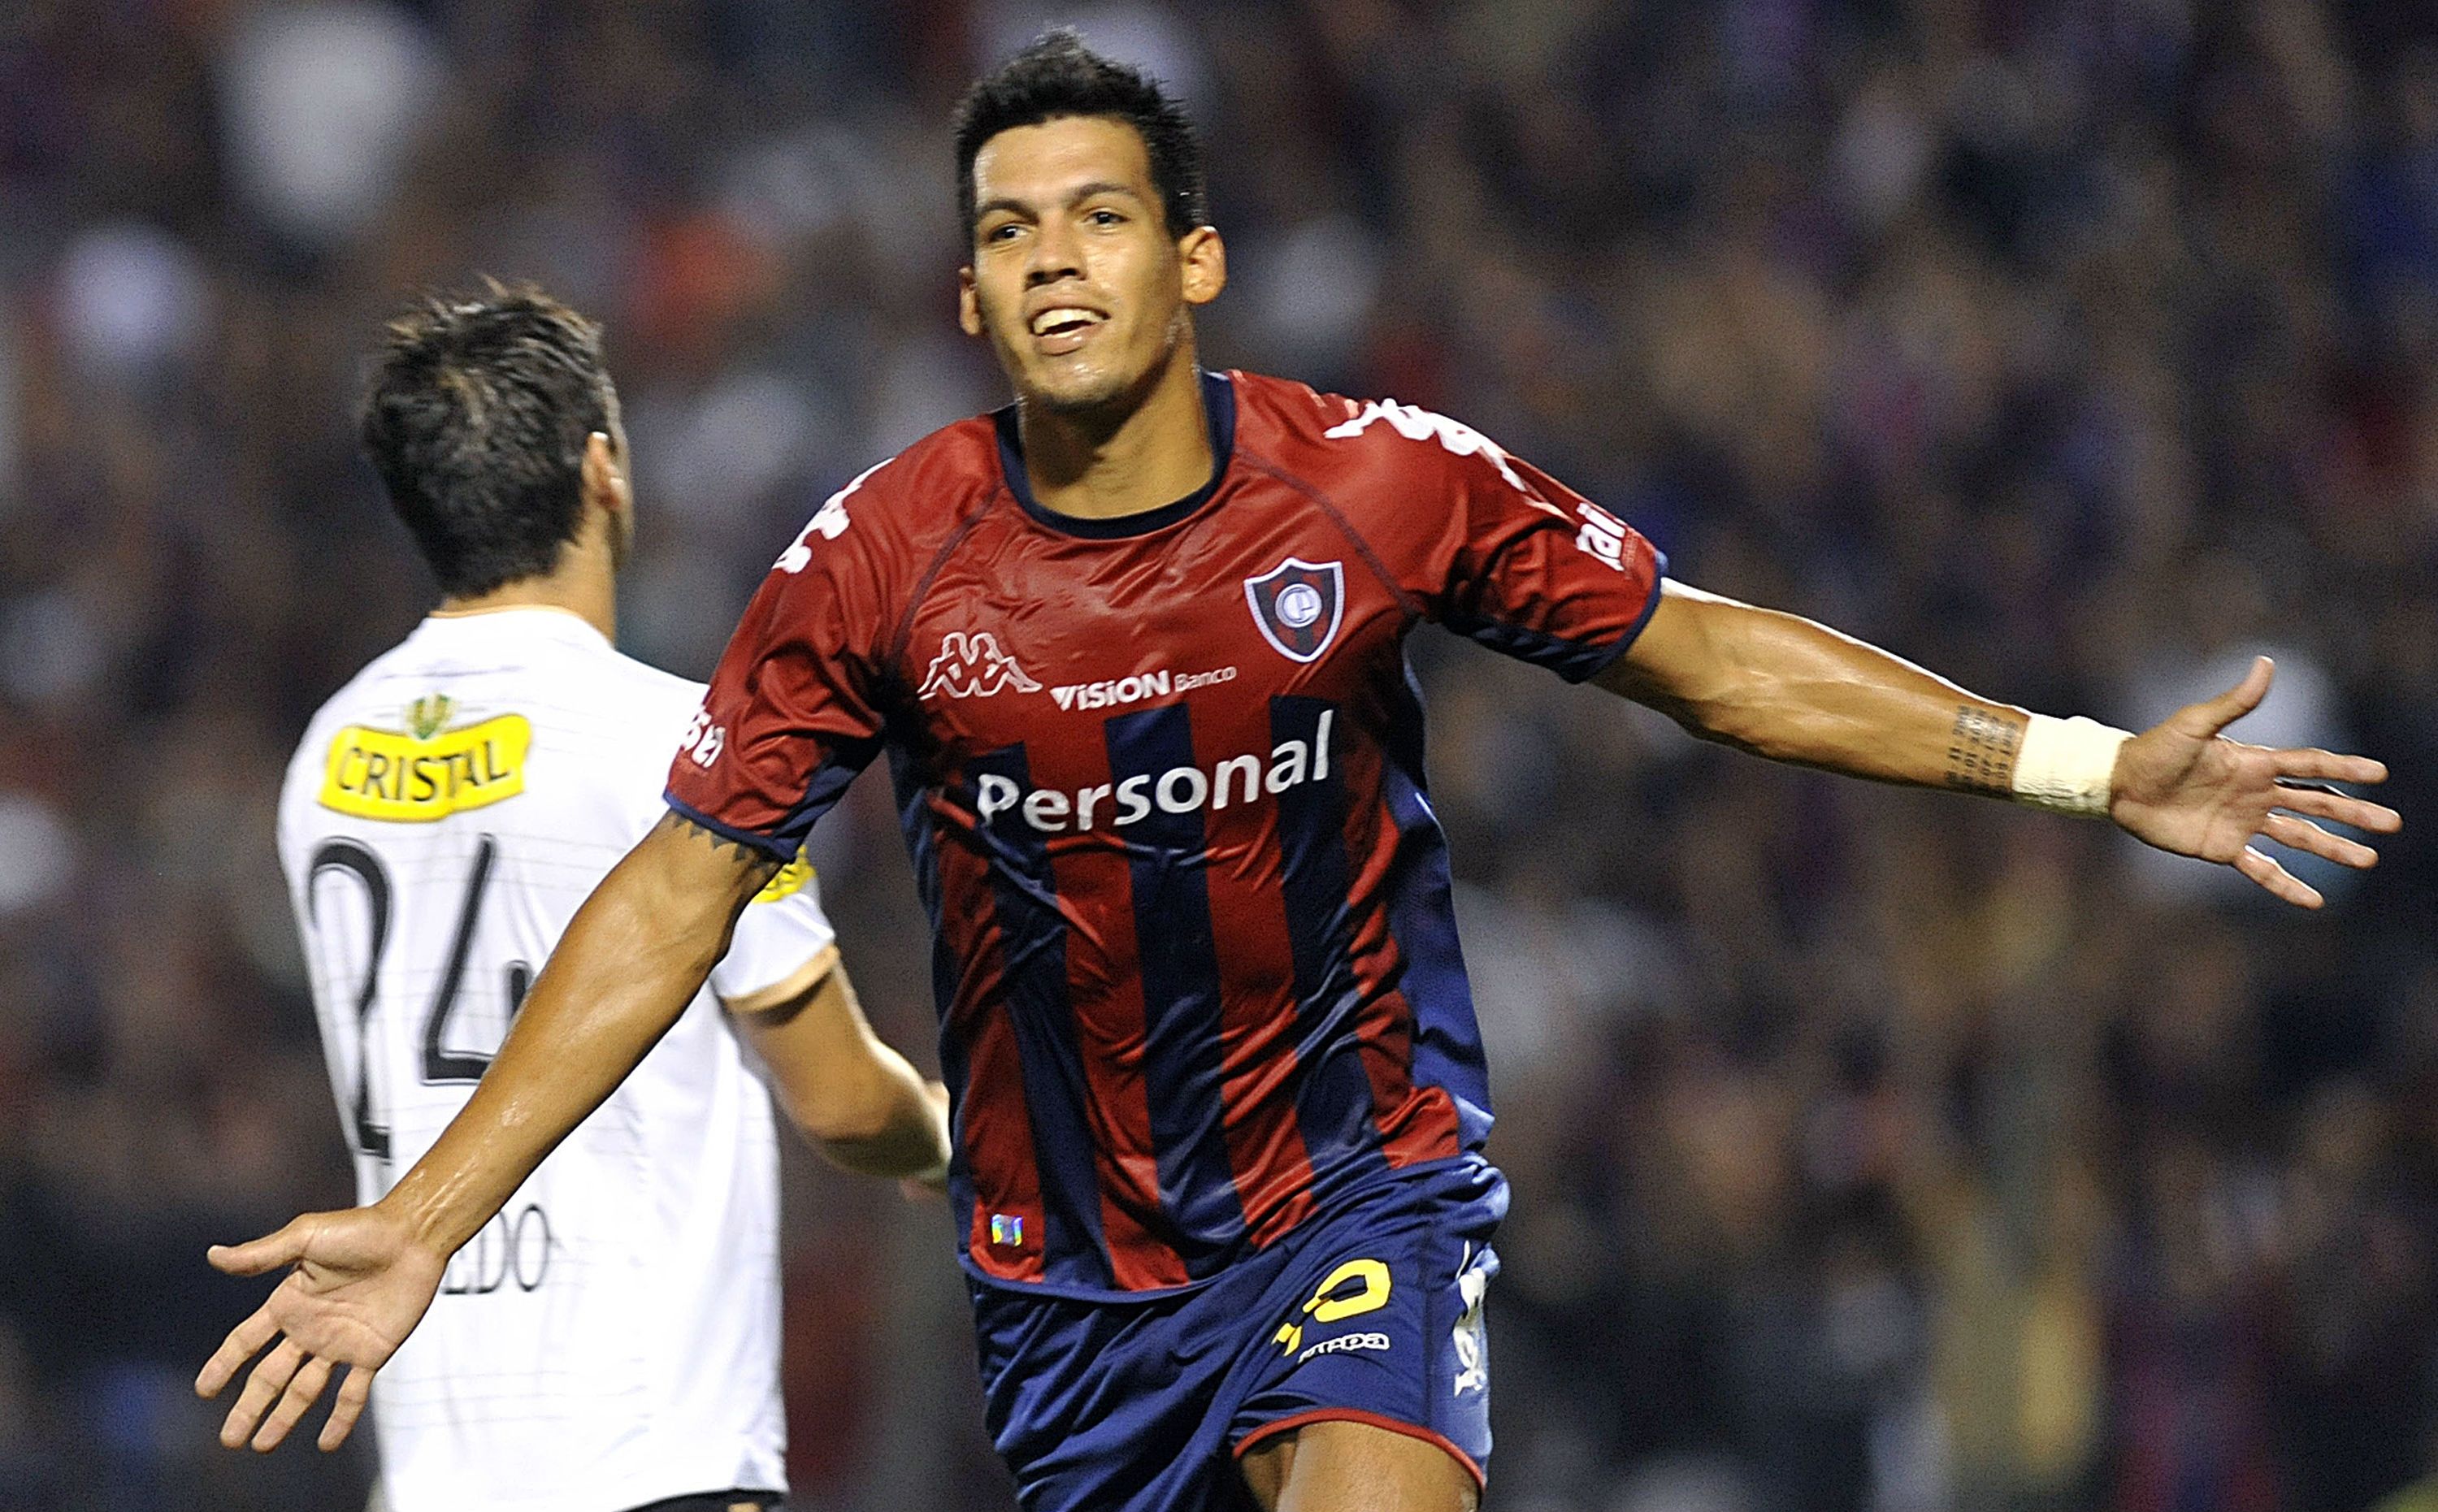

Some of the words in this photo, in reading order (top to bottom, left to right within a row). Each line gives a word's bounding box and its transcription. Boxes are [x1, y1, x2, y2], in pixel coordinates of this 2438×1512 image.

[1174, 666, 1238, 692] Banco
[336, 739, 511, 803] CRISTAL
[978, 708, 1334, 832] Personal
[306, 833, 535, 1164] 24
